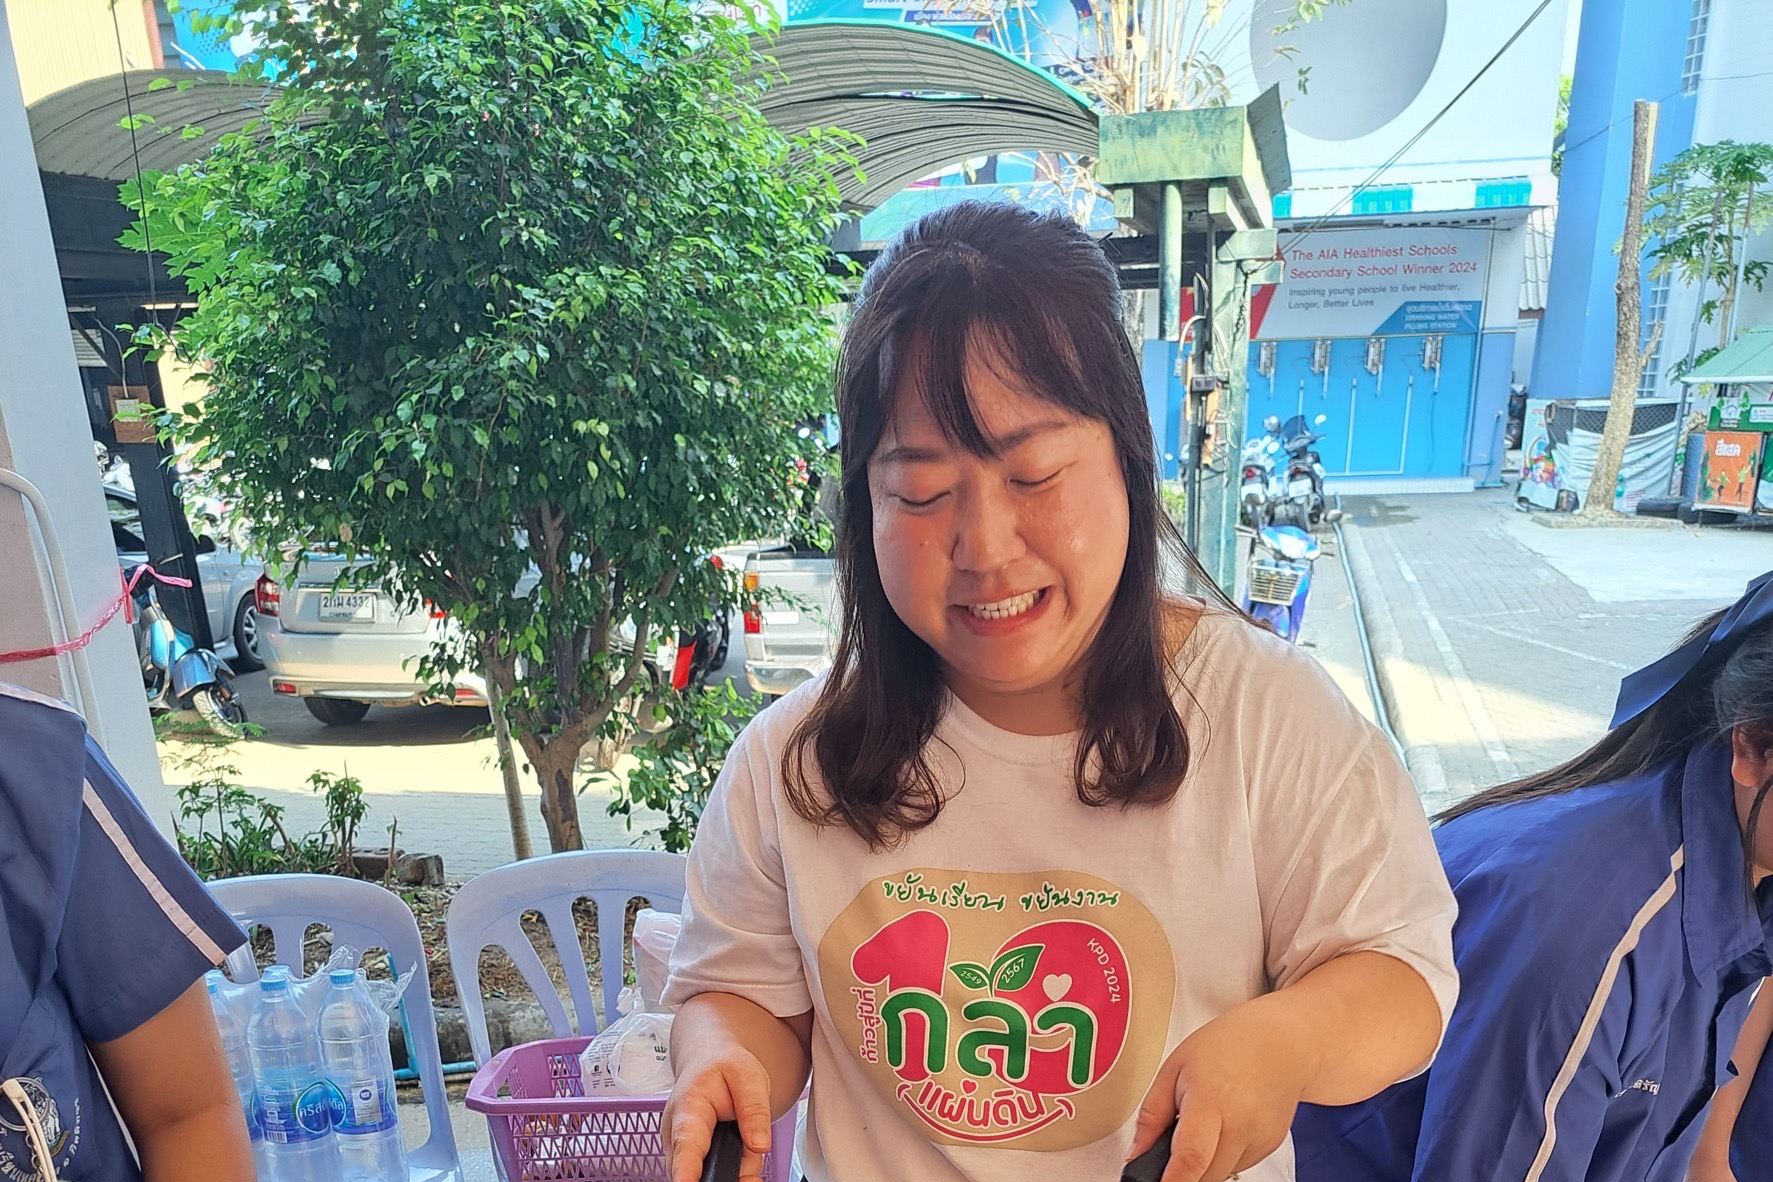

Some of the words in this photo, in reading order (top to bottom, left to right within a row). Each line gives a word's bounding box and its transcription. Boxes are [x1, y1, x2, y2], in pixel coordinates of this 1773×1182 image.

[1292, 249, 1313, 261] The
[1318, 248, 1338, 260] AIA
[1343, 246, 1404, 260] Healthiest
[1409, 244, 1457, 257] Schools
[1290, 267, 1352, 280] Secondary
[1357, 265, 1398, 277] School
[1403, 263, 1444, 275] Winner
[1449, 262, 1477, 274] 2024
[1289, 286, 1326, 298] Inspiring
[1328, 287, 1355, 298] young
[1357, 286, 1387, 297] people
[1389, 285, 1399, 293] to
[1323, 299, 1349, 308] Better
[1352, 298, 1374, 307] Lives
[884, 874, 1005, 911] ขยันเรียน
[1021, 882, 1119, 912] ขยันงาน
[960, 970, 982, 985] 2549
[1001, 957, 1025, 984] 2567
[1086, 938, 1111, 966] KPD
[1103, 966, 1122, 1004] 2024
